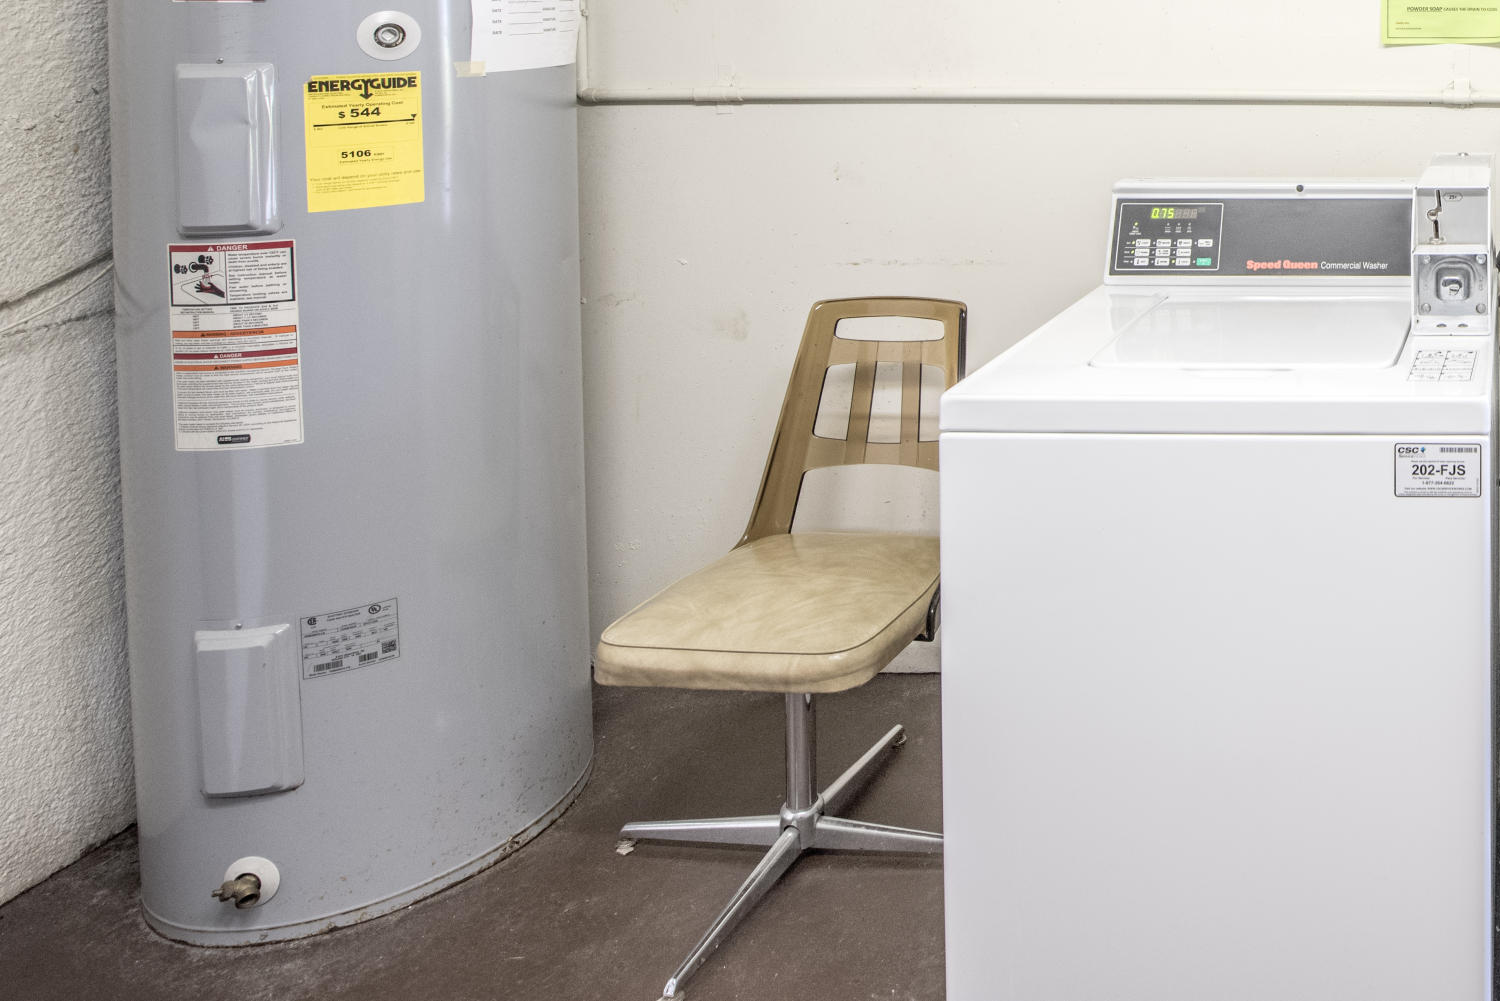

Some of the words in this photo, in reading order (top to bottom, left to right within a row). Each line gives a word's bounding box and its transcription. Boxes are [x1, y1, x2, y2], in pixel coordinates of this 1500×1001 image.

[307, 76, 417, 95] ENERGYGUIDE
[350, 107, 381, 118] 544
[341, 149, 372, 159] 5106
[1246, 259, 1282, 271] Speed
[1283, 259, 1318, 269] Queen
[1320, 261, 1361, 270] Commercial
[1362, 261, 1388, 270] Washer
[1397, 446, 1419, 454] CSC
[1411, 464, 1466, 476] 202-FJS
